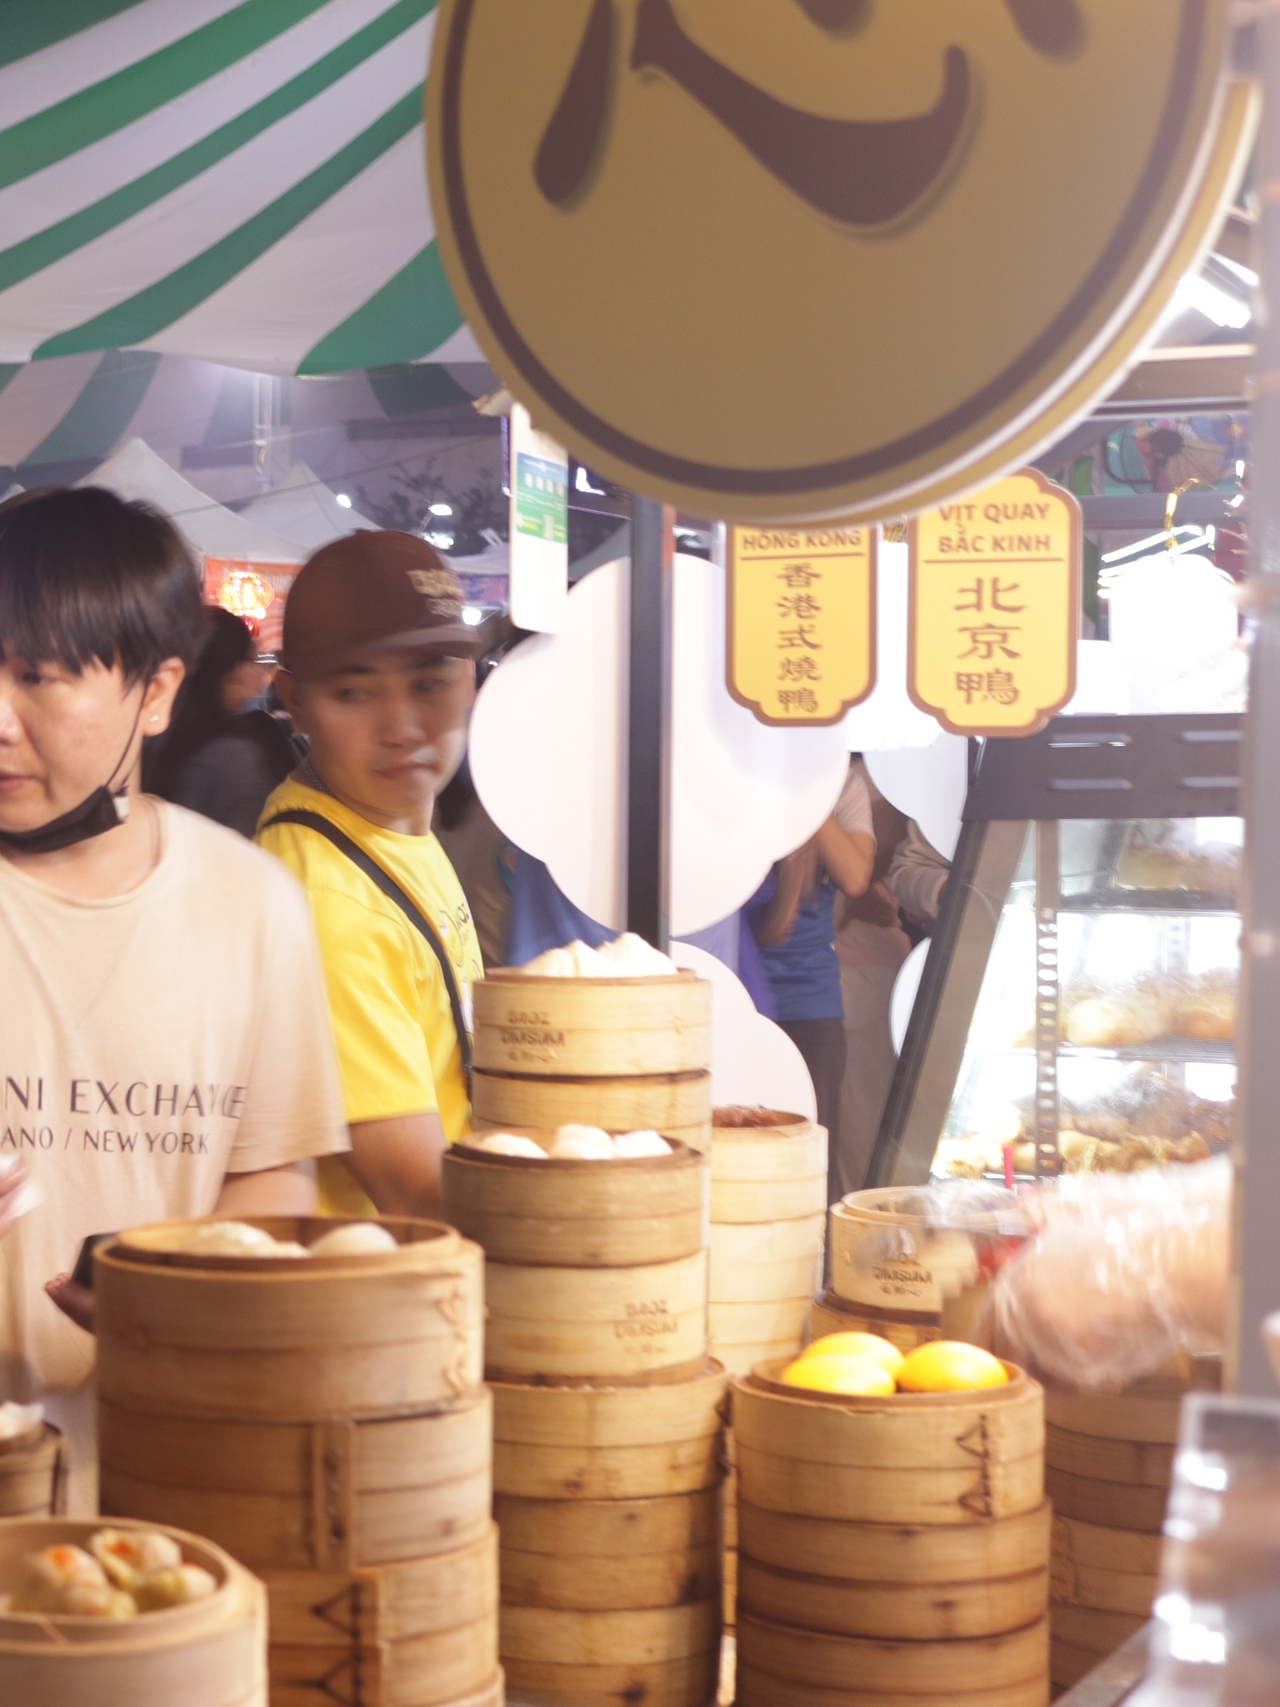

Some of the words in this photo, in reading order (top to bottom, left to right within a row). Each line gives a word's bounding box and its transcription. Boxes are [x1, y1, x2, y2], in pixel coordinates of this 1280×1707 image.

[983, 502, 1051, 524] QUAY
[990, 534, 1051, 552] KINH
[953, 575, 1027, 706] 北京鴨
[83, 1129, 139, 1153] NEW
[145, 1130, 210, 1155] YORK
